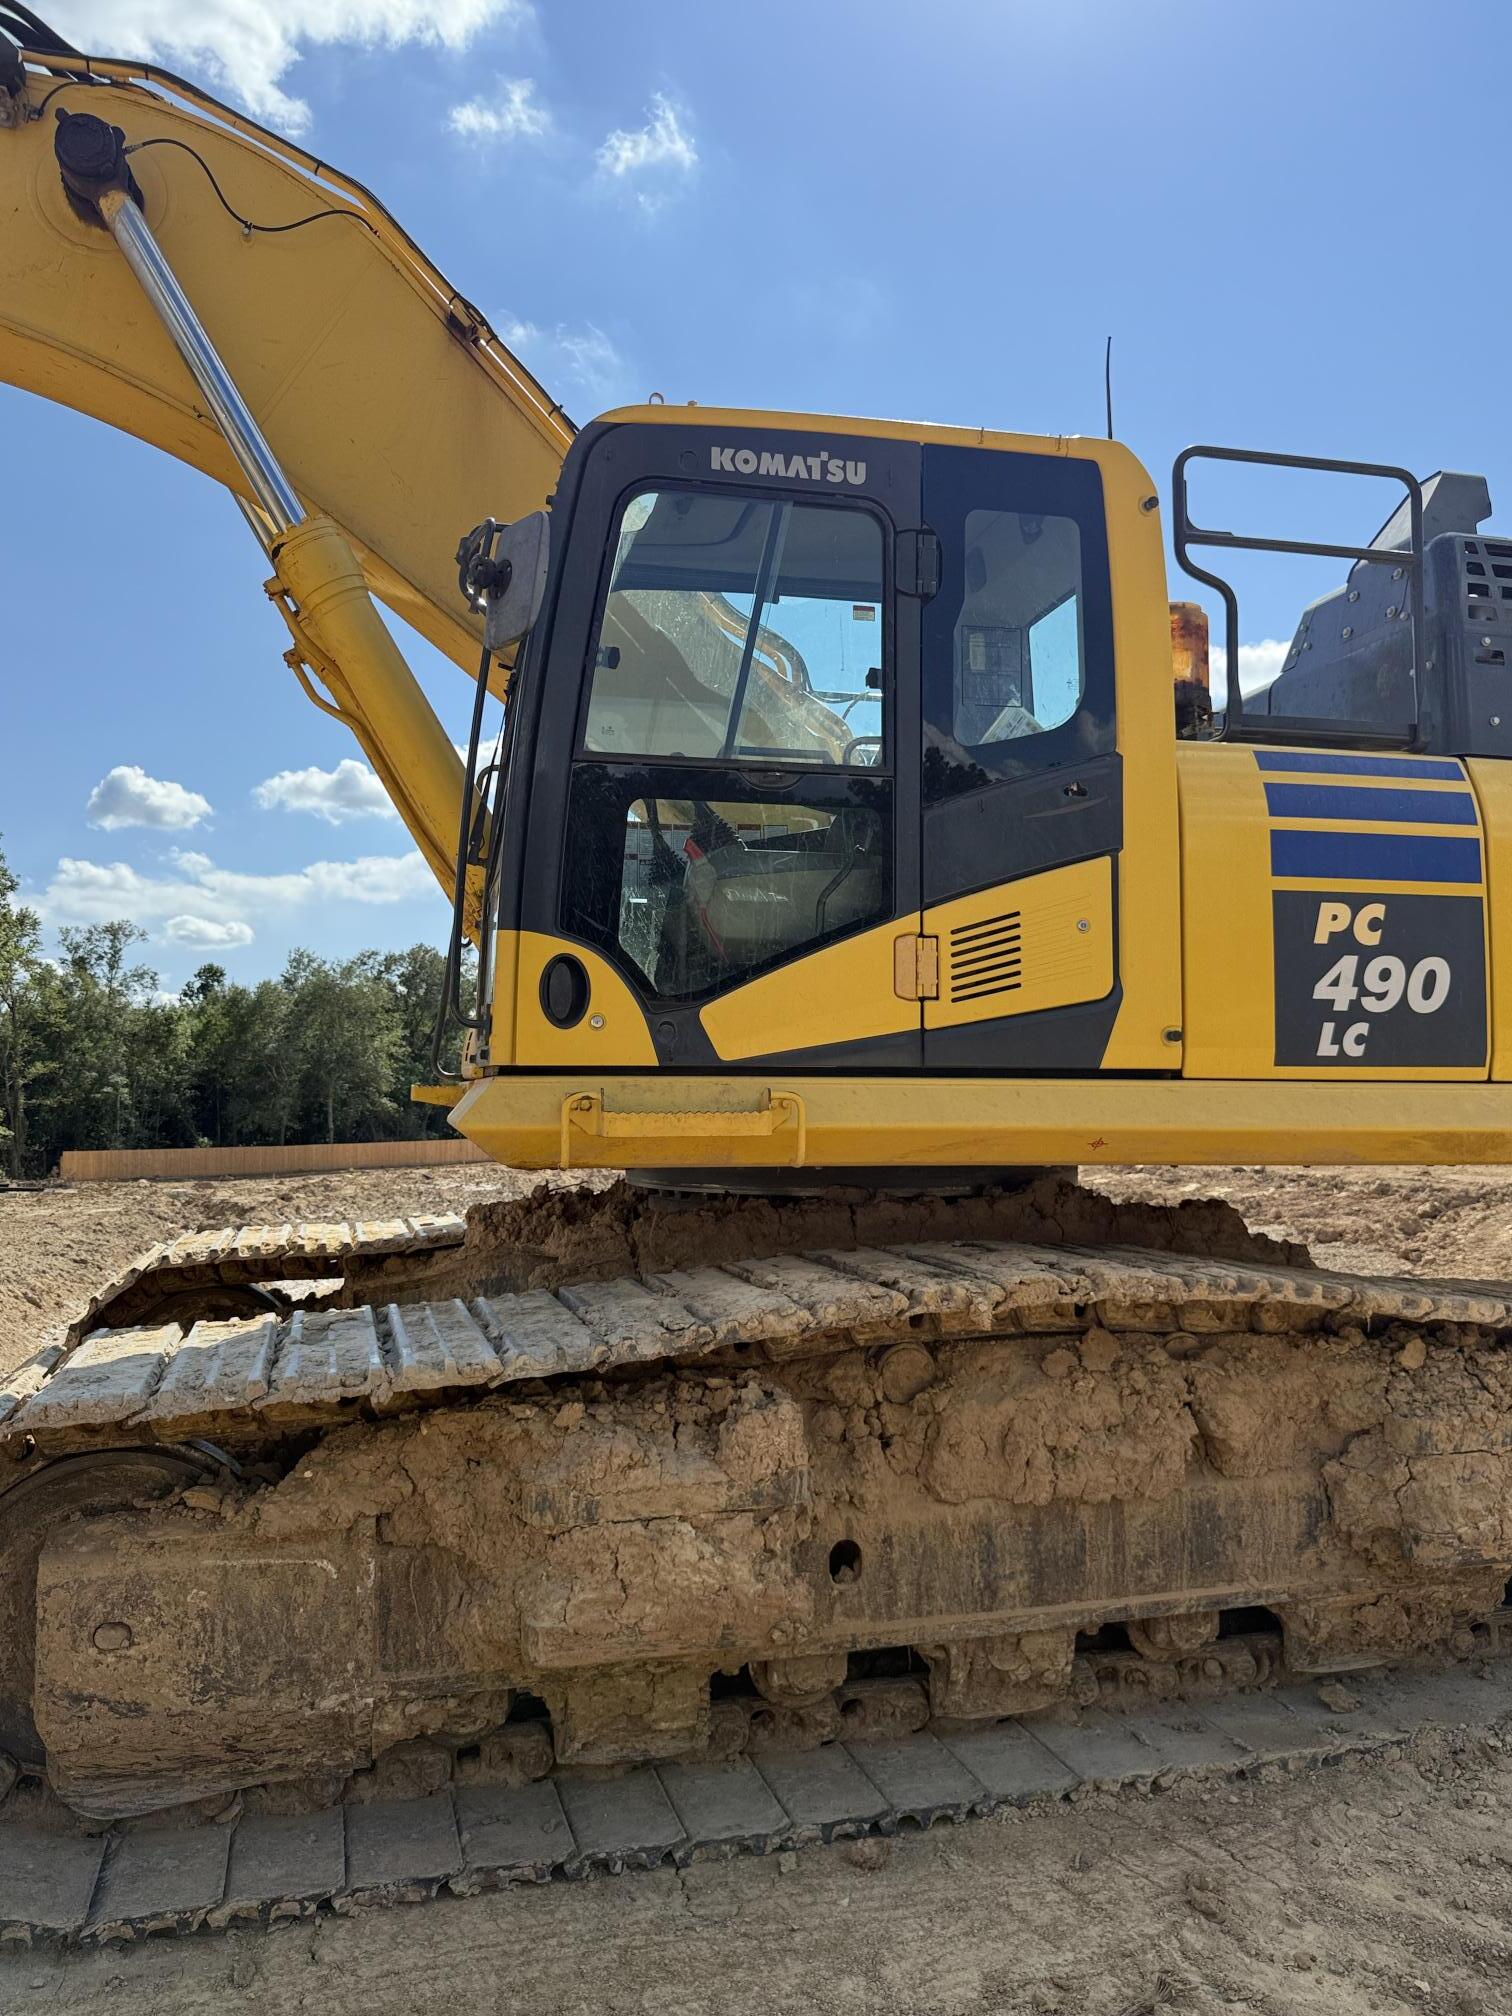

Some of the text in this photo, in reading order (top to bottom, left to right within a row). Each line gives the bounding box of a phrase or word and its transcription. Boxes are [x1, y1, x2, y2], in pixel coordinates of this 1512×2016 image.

[711, 447, 866, 485] KOMATSU
[1313, 902, 1386, 946] PC
[1312, 955, 1451, 1014] 490
[1316, 1021, 1370, 1058] LC
